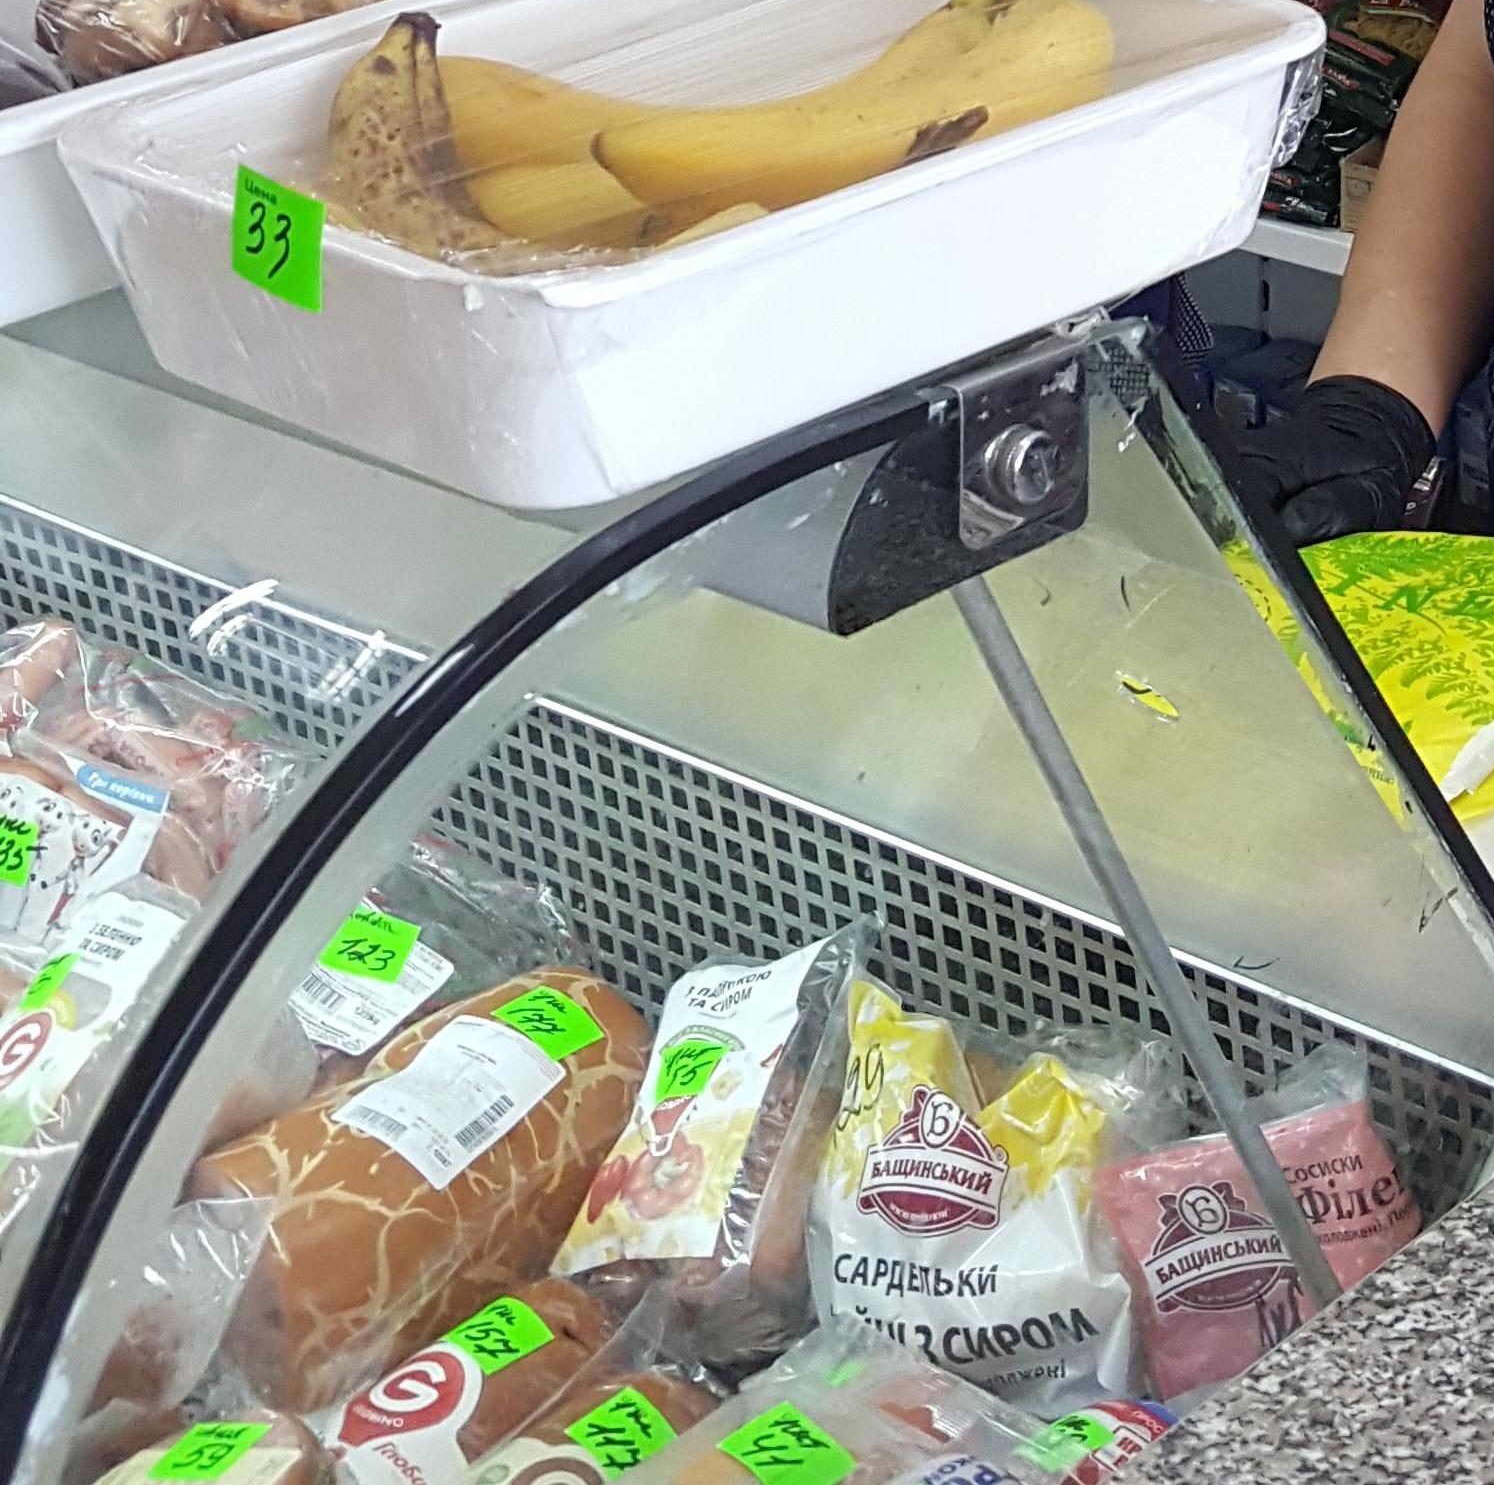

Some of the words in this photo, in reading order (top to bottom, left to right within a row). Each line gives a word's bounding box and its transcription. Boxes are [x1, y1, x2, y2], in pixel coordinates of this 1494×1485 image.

[243, 176, 279, 206] Цена
[244, 200, 293, 280] 33
[870, 1157, 994, 1197] БАЩИНСЬКИЙ
[1296, 1168, 1406, 1226] Філе
[833, 1251, 1000, 1300] САРДЕЛЬКИ
[1155, 1233, 1283, 1285] БАЩИНСЬКИЙ
[942, 1307, 1100, 1367] СИРОМ
[368, 1359, 449, 1414] G
